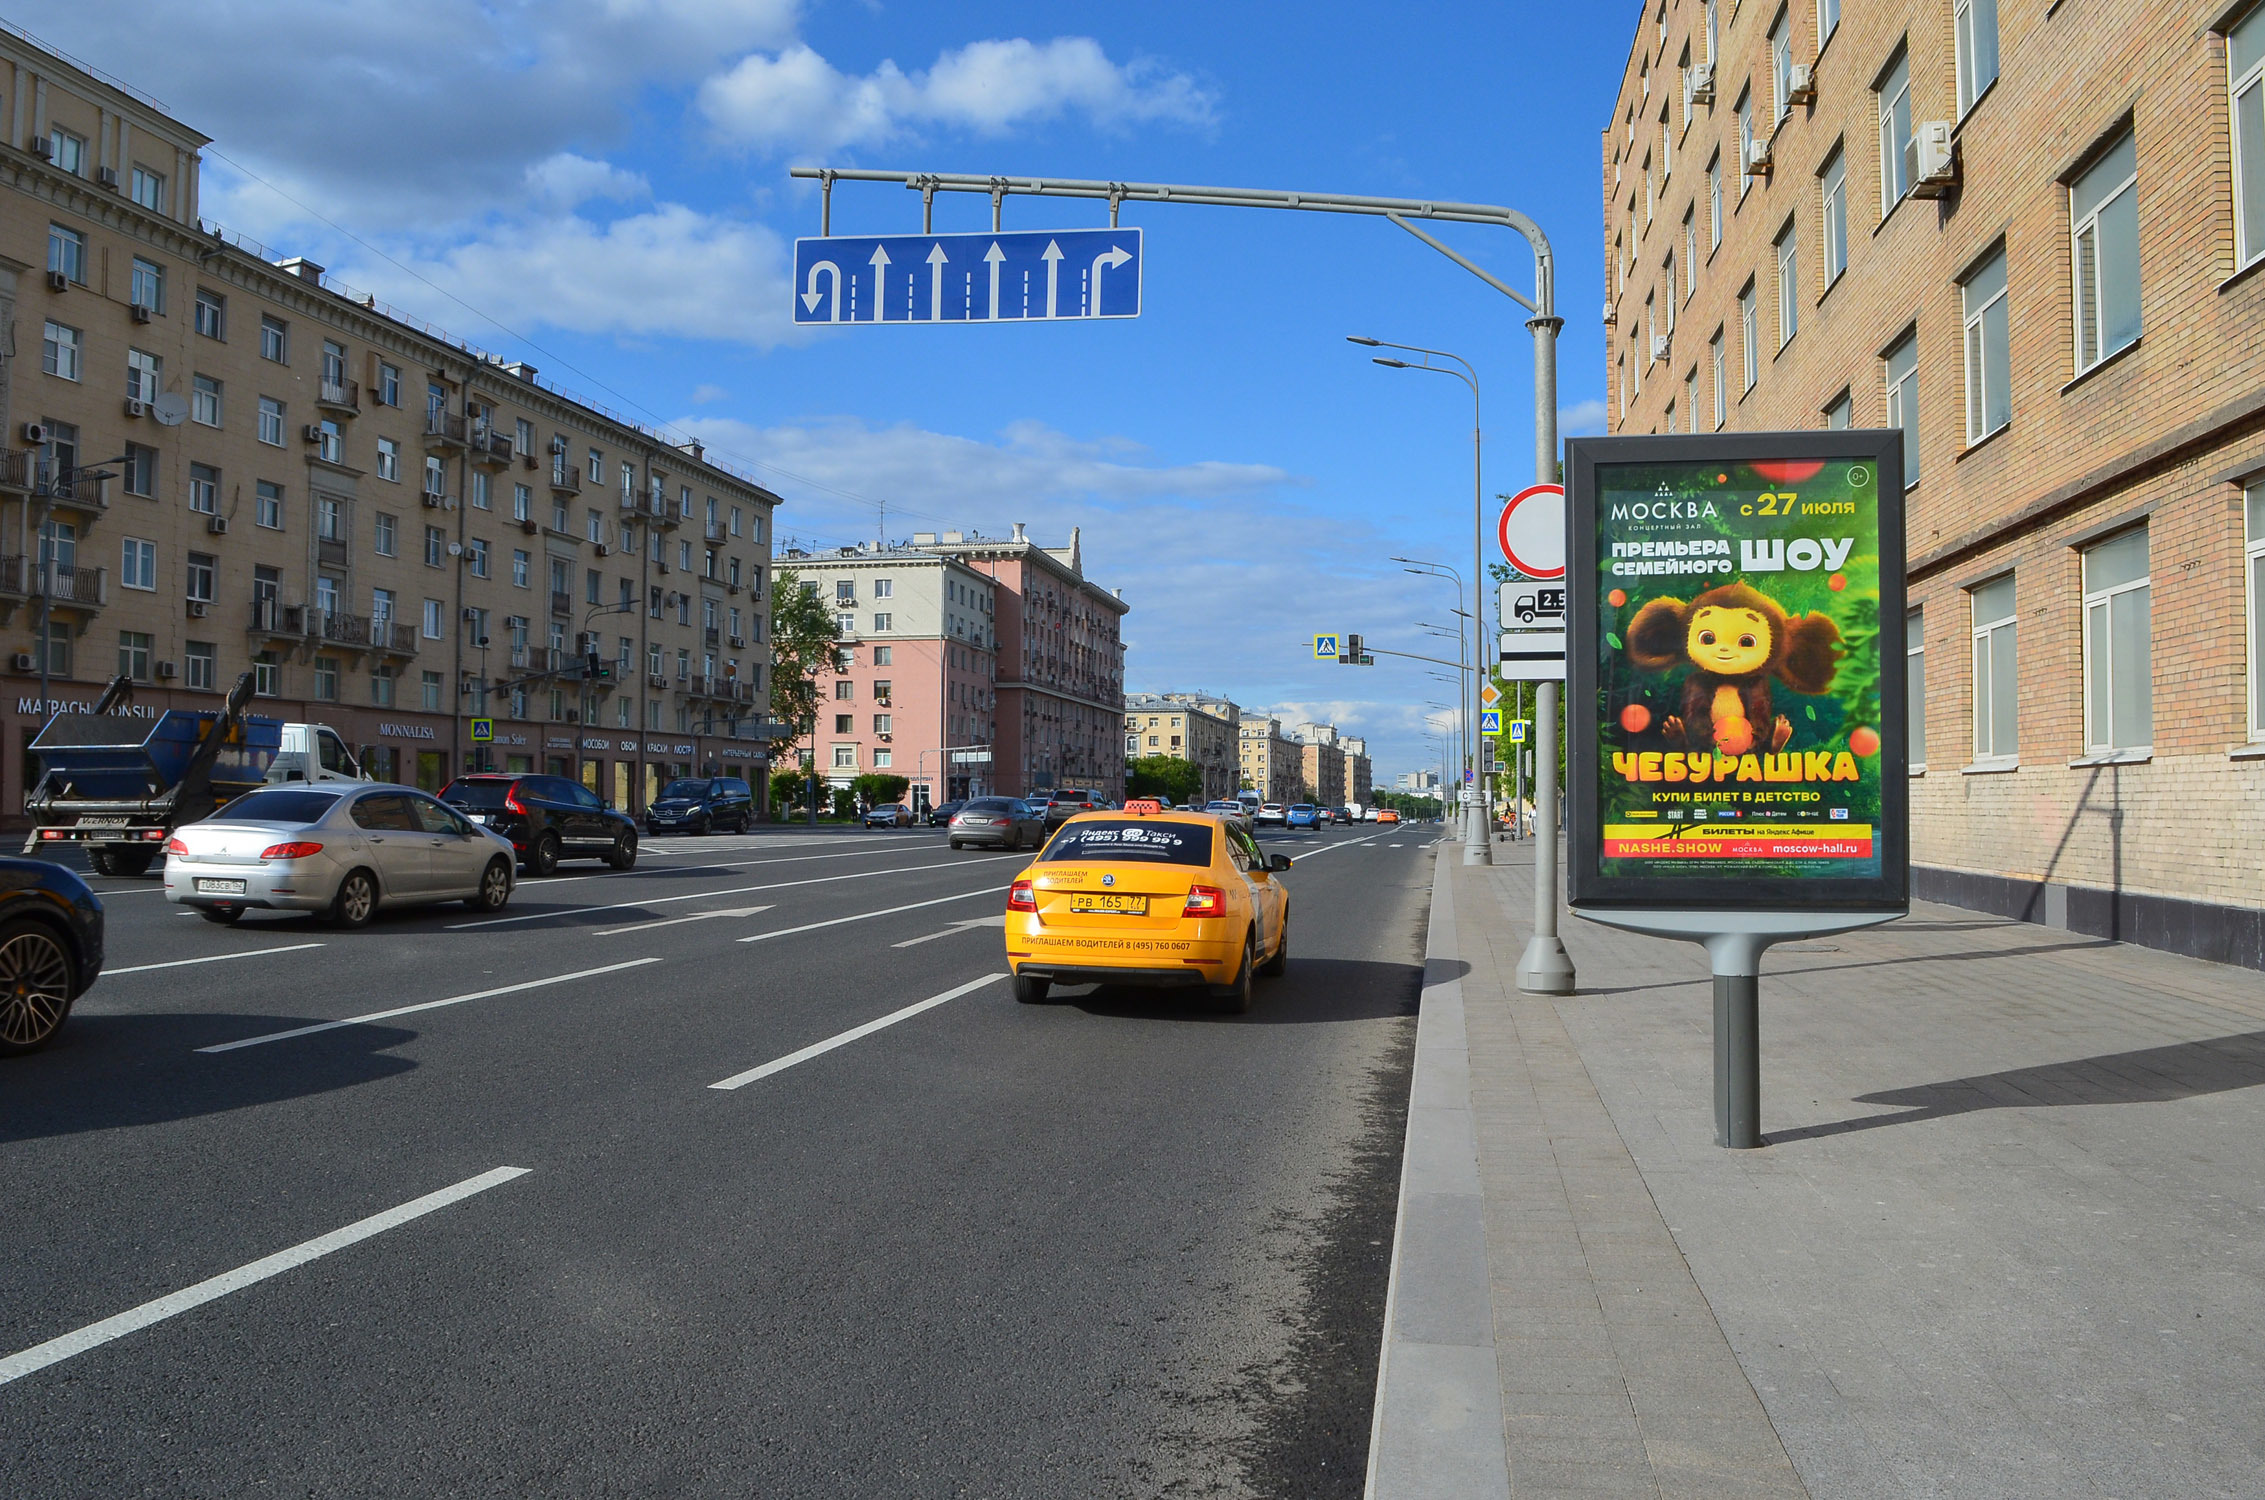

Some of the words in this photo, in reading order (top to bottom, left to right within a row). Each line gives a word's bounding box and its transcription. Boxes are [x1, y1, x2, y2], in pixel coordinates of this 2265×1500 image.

[1852, 471, 1864, 482] 0+
[1611, 500, 1718, 521] МОСКВА
[1757, 493, 1798, 516] 27
[1628, 523, 1682, 531] КОНЦЕРТНЫЙ
[1611, 540, 1731, 558] ПРЕМЬЕРА
[1740, 537, 1855, 572] ШОУ
[1611, 558, 1733, 576] СЕМЕЙНОГО
[1543, 593, 1565, 607] 2,5
[380, 723, 434, 739] MONNALISA
[492, 735, 510, 744] amon
[620, 741, 637, 752] ОБОИ
[646, 743, 668, 754] КРАСКИ
[1612, 751, 1860, 783] ЧЕБУРАШКА
[1652, 793, 1690, 803] КУПИ
[1694, 792, 1740, 803] БИЛЕТ
[1743, 792, 1752, 802] В
[1755, 792, 1821, 804] ДЕТСТВО
[1080, 829, 1120, 837] Яндекс
[1146, 830, 1177, 839] Такси
[1766, 828, 1789, 837] Яндекс
[1080, 835, 1118, 843] (495)
[1618, 843, 1722, 853] NASHE.SHOW
[1773, 842, 1858, 853] moscow-hall.ru
[1100, 896, 1122, 908] 165
[1130, 896, 1142, 906] 77
[1022, 936, 1074, 947] ПРИГЛАШАЕМ
[1076, 938, 1124, 949] ВОДИТЕЛЕЙ
[1126, 941, 1131, 949] 8
[1132, 941, 1153, 951] (495)
[1155, 942, 1170, 950] 760
[1171, 942, 1191, 951] 0607
